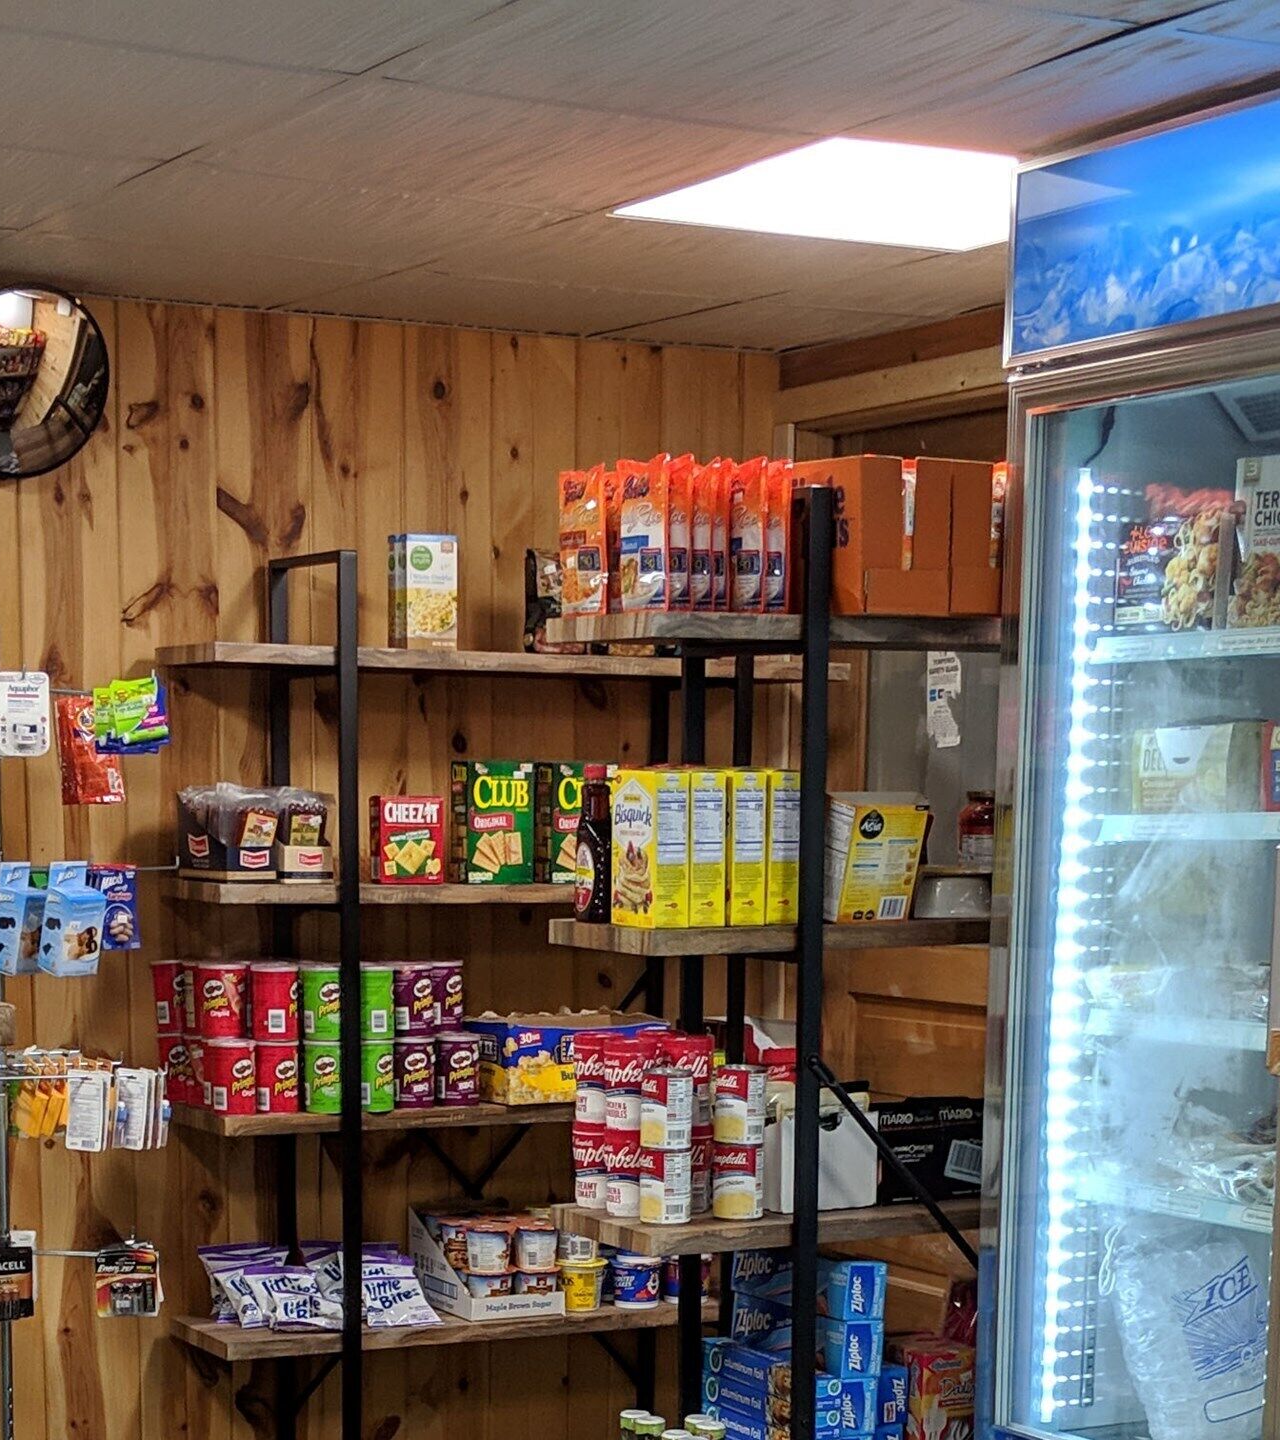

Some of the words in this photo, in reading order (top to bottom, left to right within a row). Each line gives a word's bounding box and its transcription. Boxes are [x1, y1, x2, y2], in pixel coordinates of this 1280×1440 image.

[8, 685, 40, 695] Aquaphor
[473, 775, 529, 809] CLUB
[473, 815, 507, 829] ORIGINAL
[614, 803, 652, 828] Bisquick
[314, 1072, 340, 1090] Pringles
[404, 1069, 432, 1087] Pringles
[449, 1066, 478, 1085] Pringles
[880, 1113, 914, 1126] MARIO
[938, 1108, 973, 1121] MARIO
[735, 1253, 773, 1279] Ziploc
[851, 1275, 863, 1313] Ziploc
[1200, 1263, 1254, 1311] ICE
[486, 1303, 507, 1313] Maple
[509, 1302, 531, 1311] Brown
[532, 1300, 552, 1310] Sugar
[735, 1307, 771, 1333] Ziploc
[848, 1333, 860, 1371] Ziploc
[723, 1358, 753, 1376] aluminum
[754, 1366, 765, 1380] foil
[720, 1386, 750, 1405] aluminum
[750, 1395, 762, 1410] foil
[892, 1377, 905, 1413] Ziploc
[842, 1393, 852, 1429] Ziploc
[750, 1425, 762, 1440] foil
